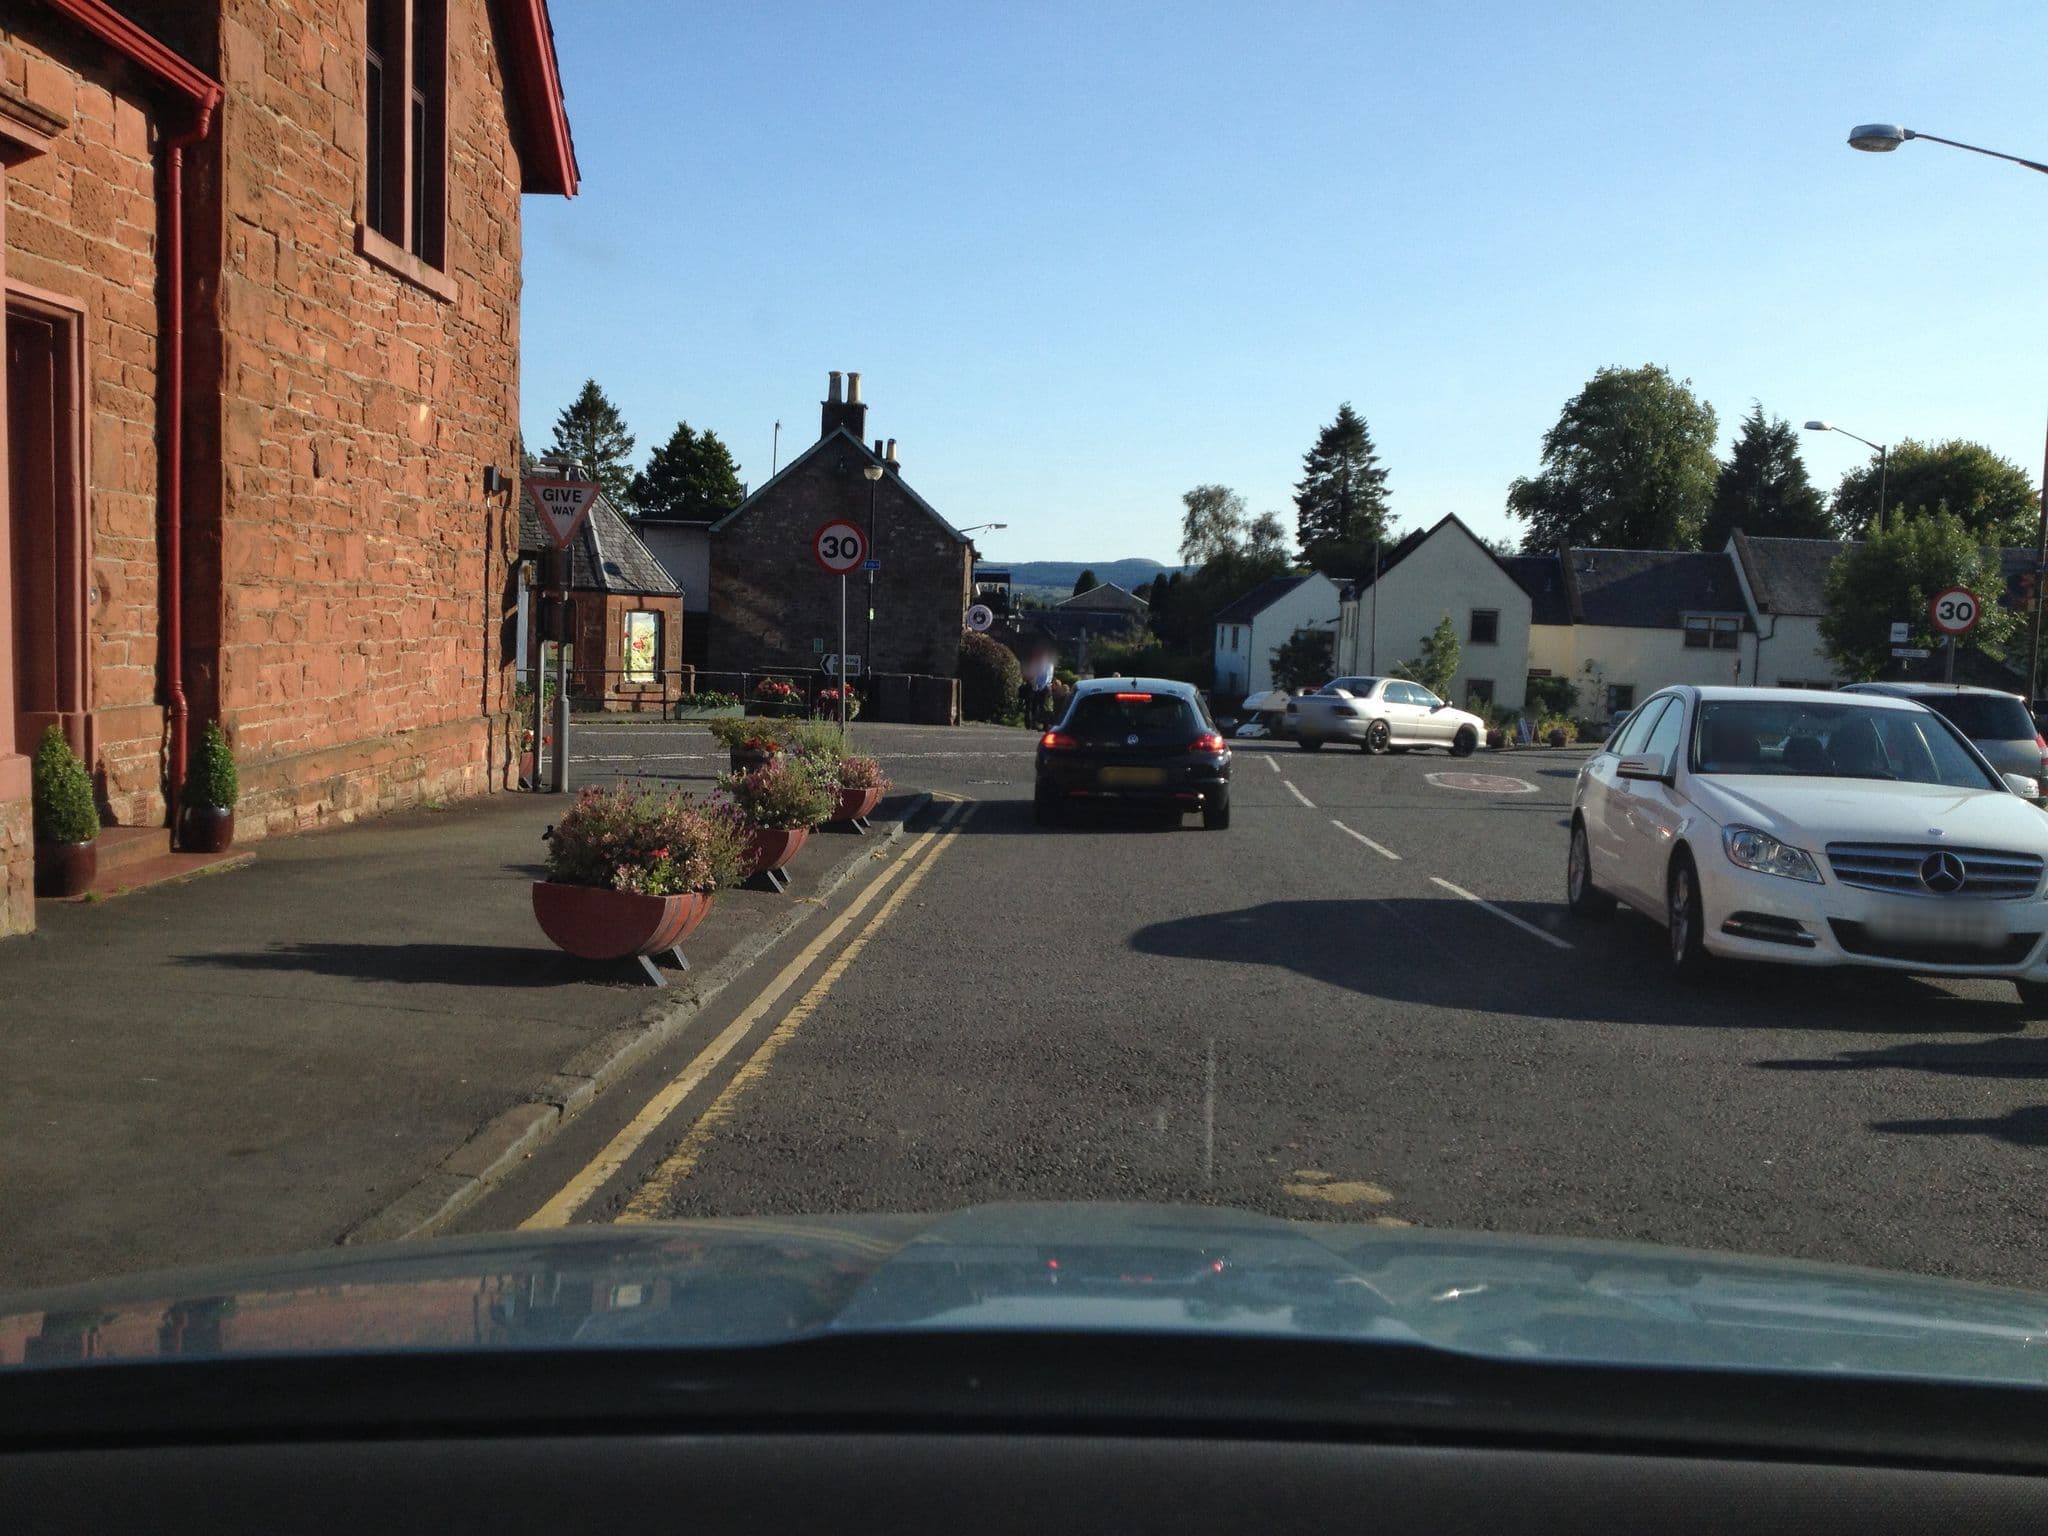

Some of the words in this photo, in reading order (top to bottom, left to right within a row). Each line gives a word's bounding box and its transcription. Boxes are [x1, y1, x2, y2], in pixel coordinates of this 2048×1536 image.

[542, 488, 582, 503] GIVE
[551, 505, 576, 516] WAY
[822, 535, 858, 559] 30
[1939, 601, 1973, 621] 30
